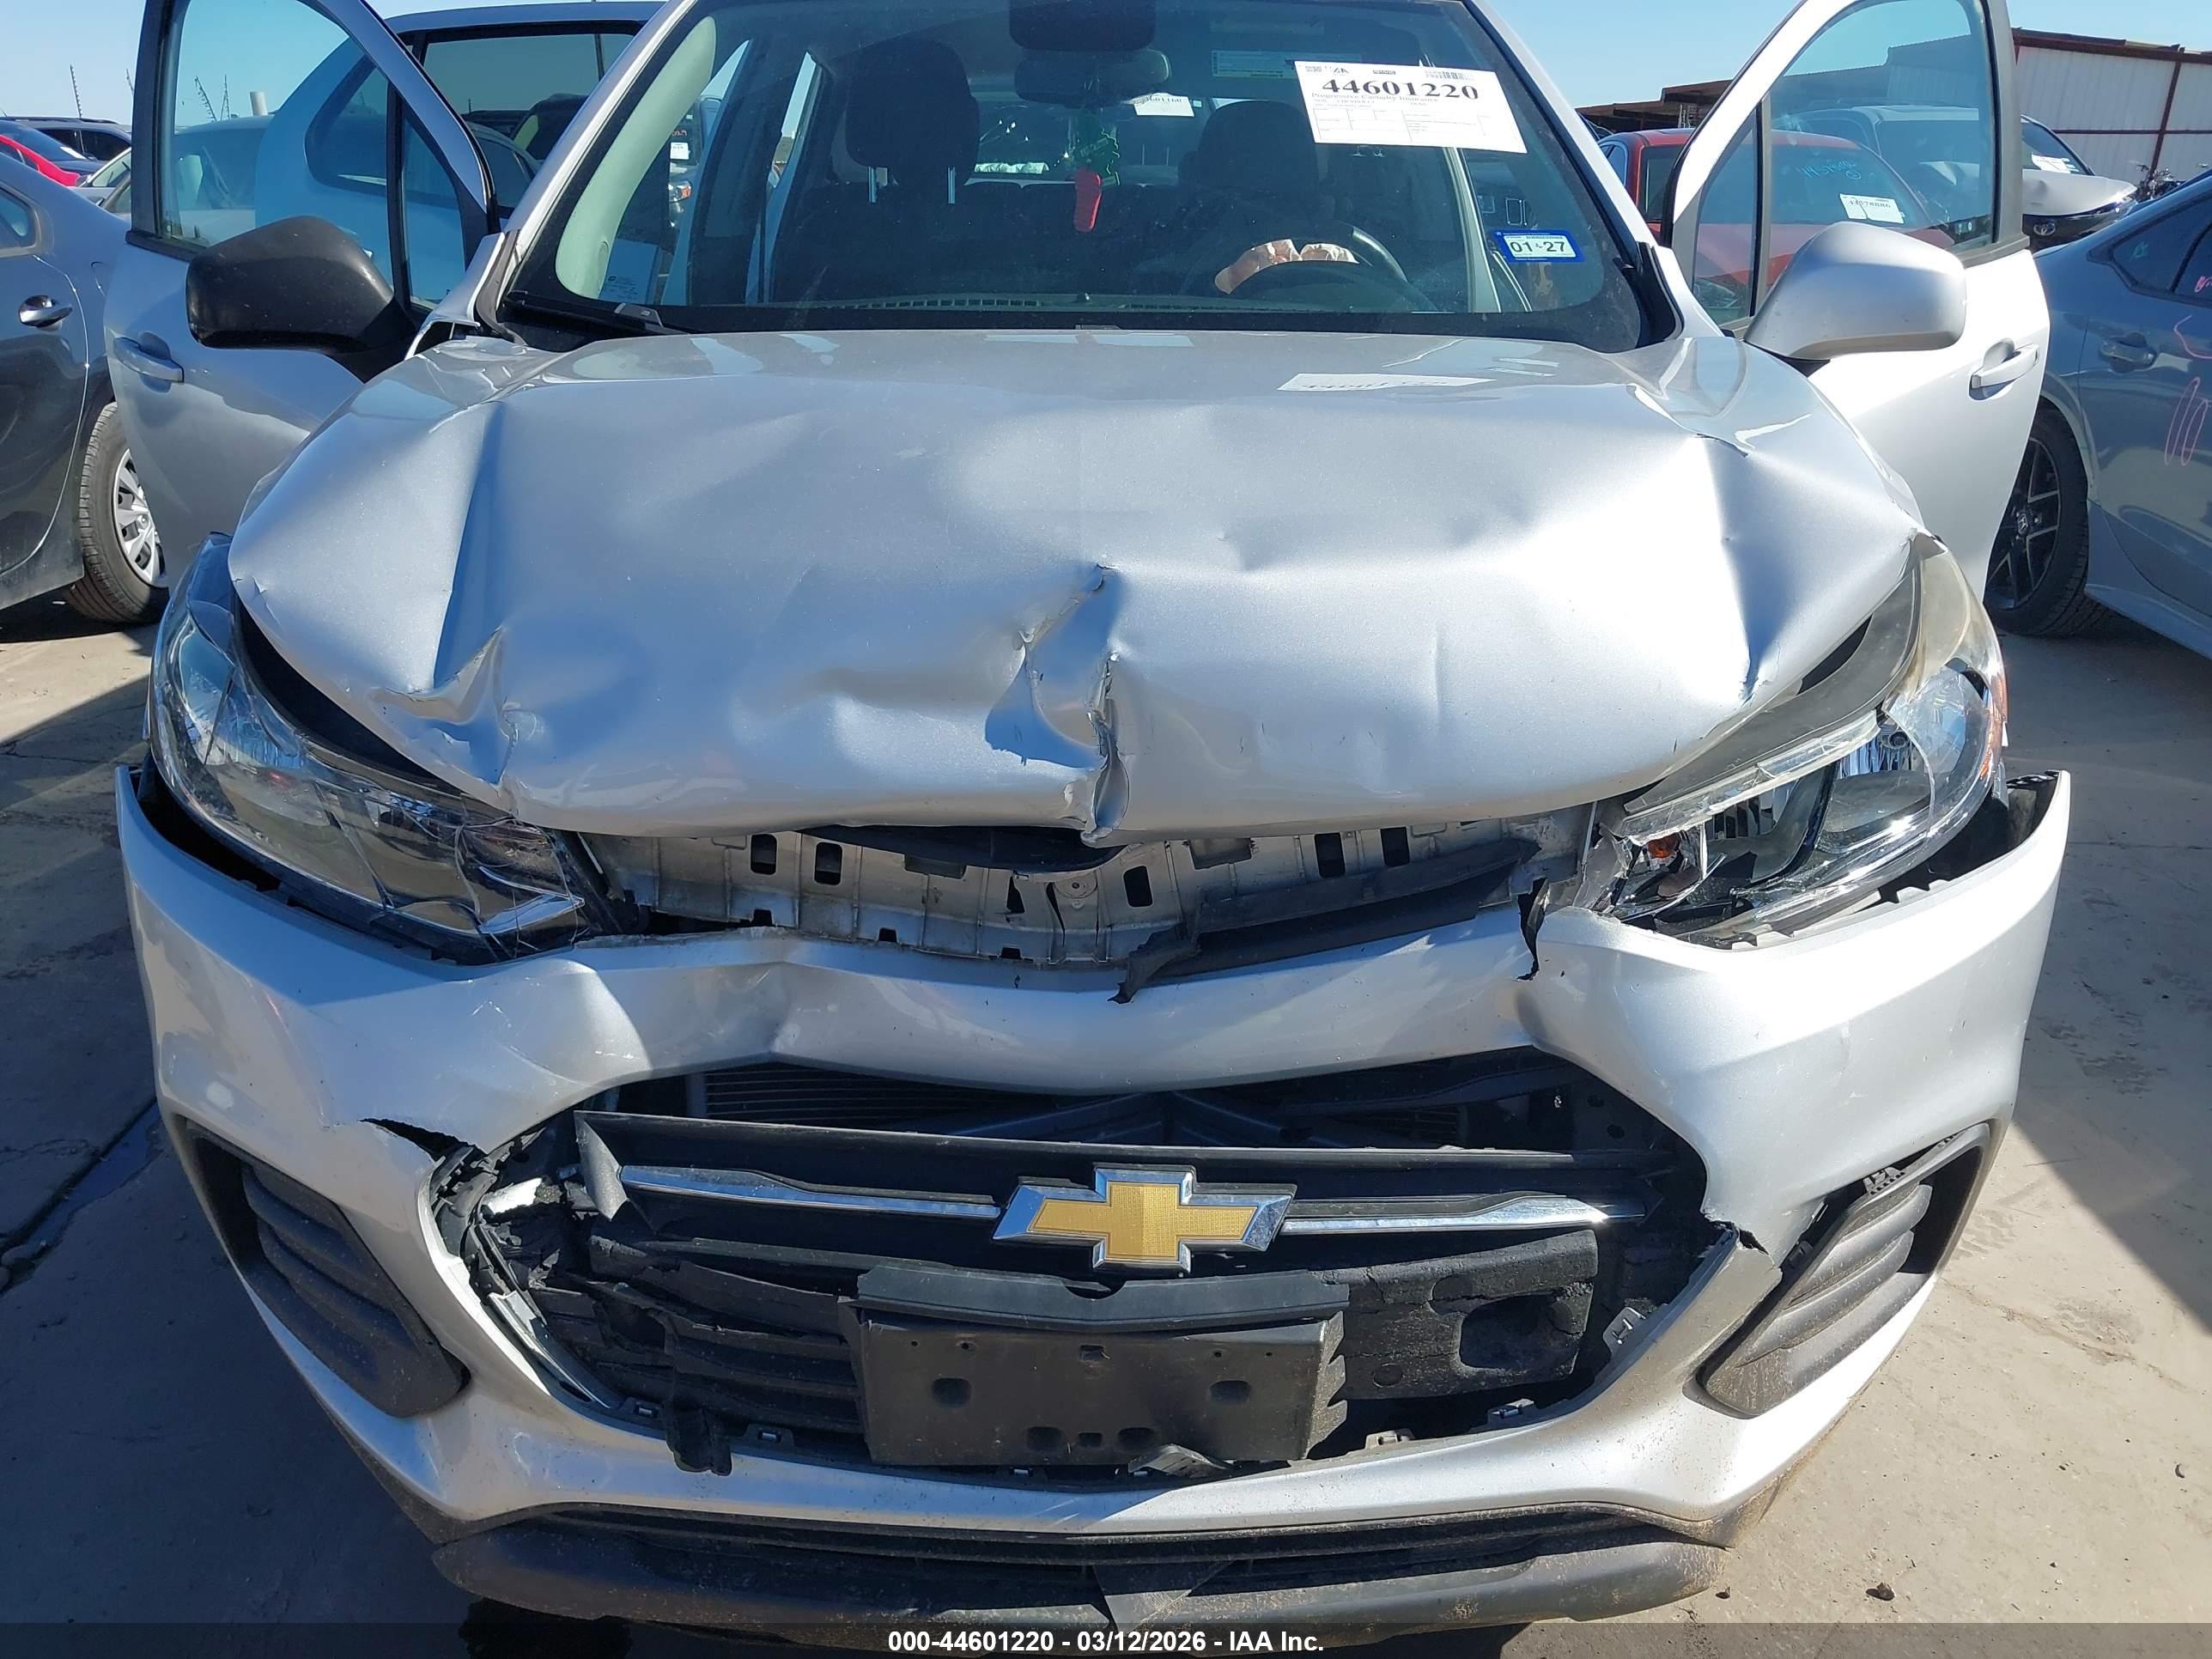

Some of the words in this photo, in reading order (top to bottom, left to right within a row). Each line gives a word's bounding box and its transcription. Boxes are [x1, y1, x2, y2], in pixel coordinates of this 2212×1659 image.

[1322, 78, 1479, 100] 44601220
[1510, 241, 1533, 253] 01
[1543, 241, 1565, 252] 27
